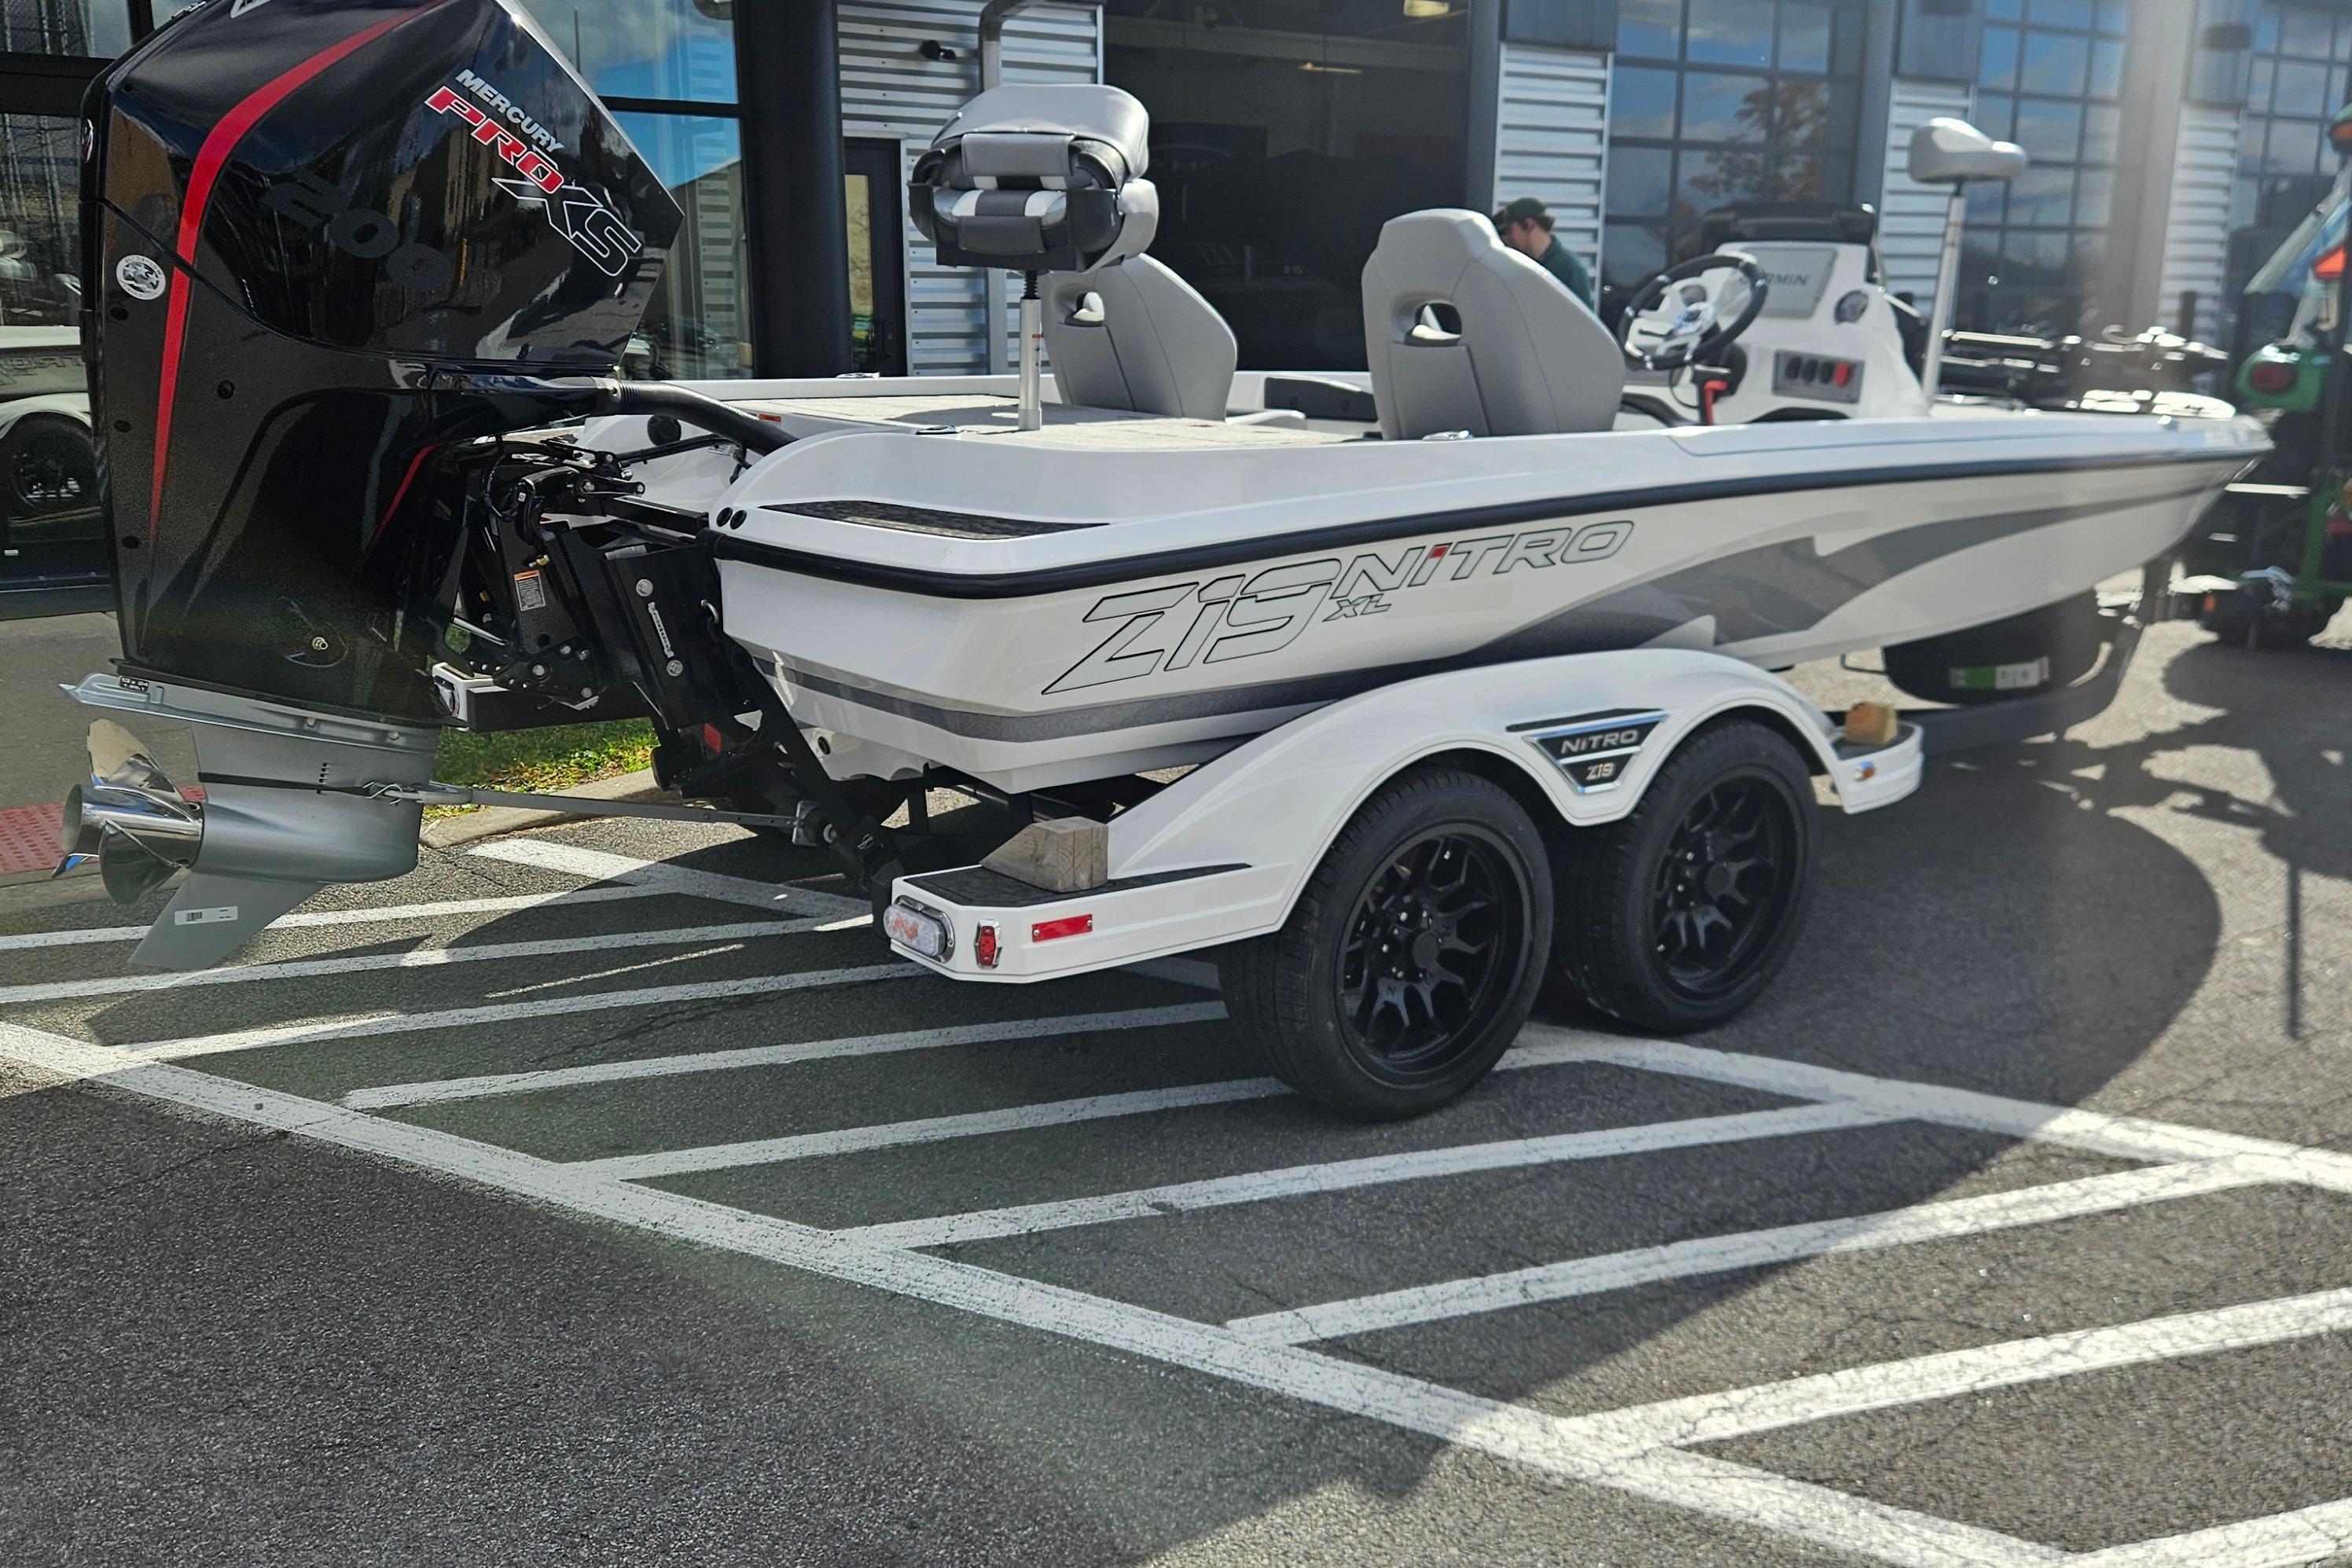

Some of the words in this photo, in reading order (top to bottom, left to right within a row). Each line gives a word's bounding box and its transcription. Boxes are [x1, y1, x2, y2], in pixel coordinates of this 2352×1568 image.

[424, 86, 564, 194] PRO
[454, 68, 564, 152] MERCURY
[491, 145, 642, 277] XS
[1329, 520, 1635, 600] NITRO
[1321, 593, 1392, 622] XL
[1560, 729, 1639, 755] NITRO
